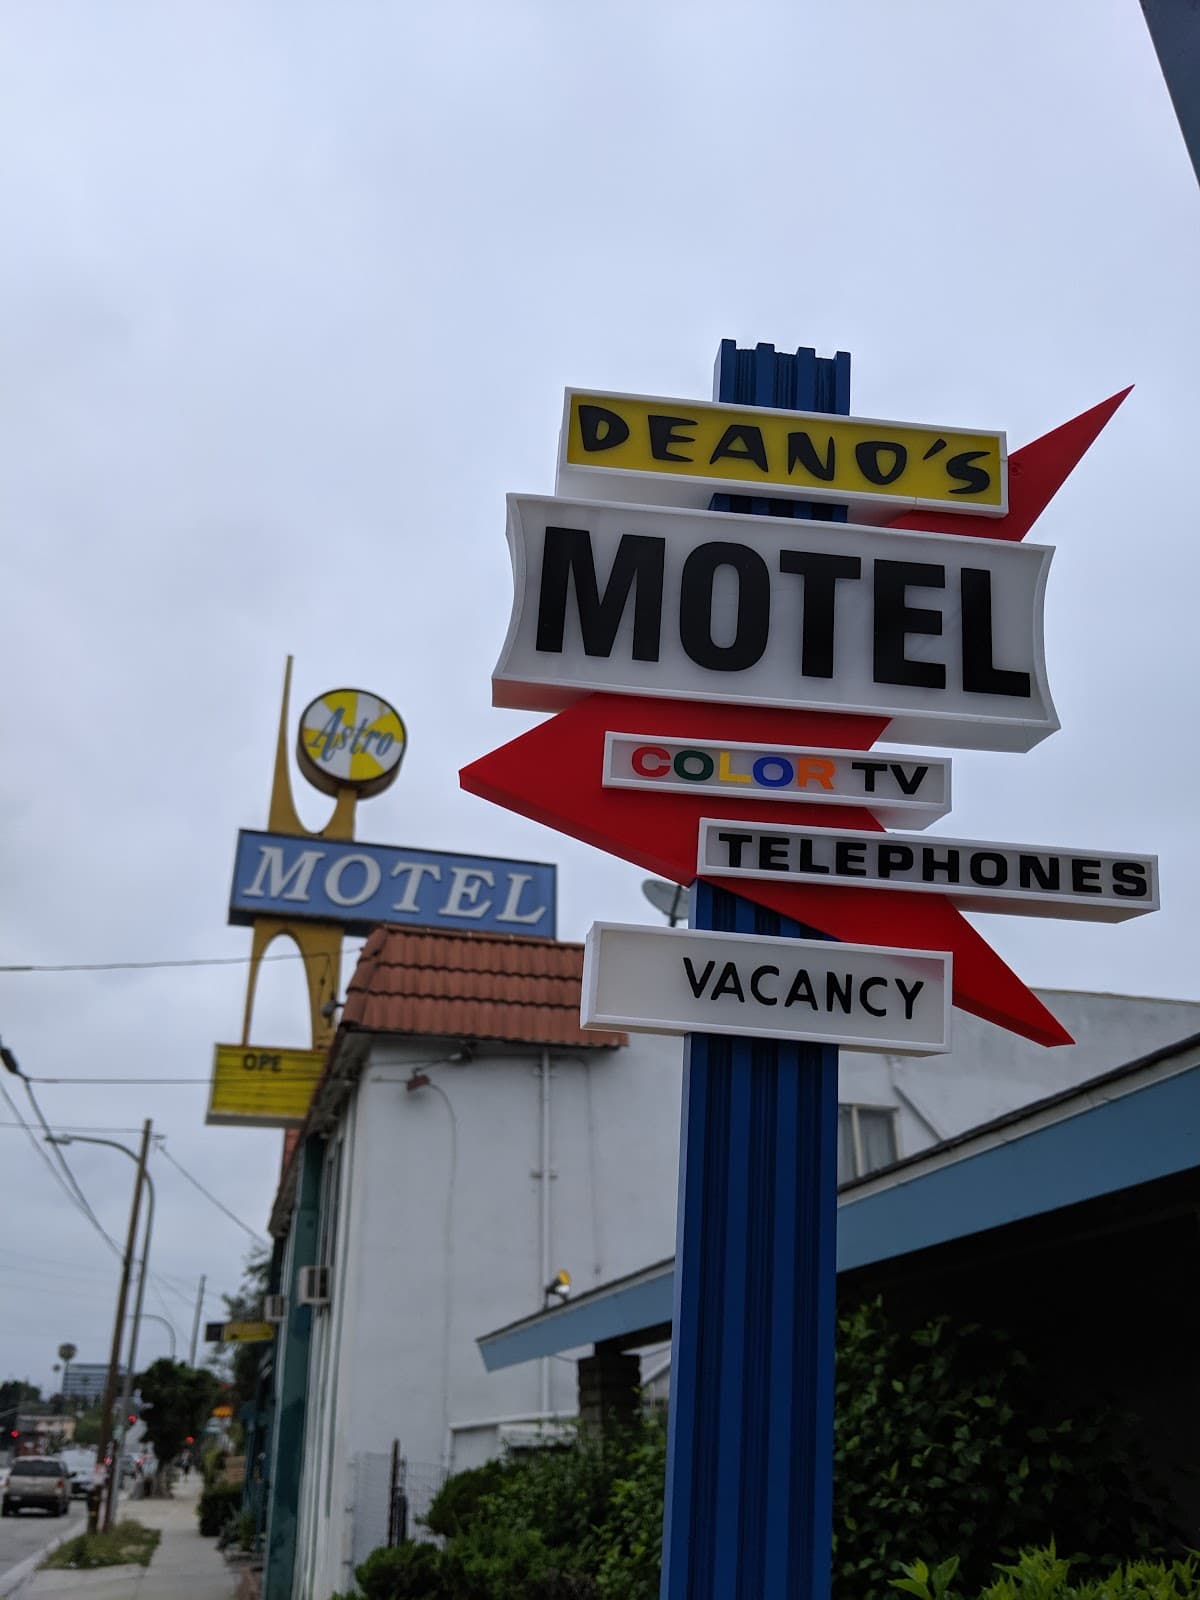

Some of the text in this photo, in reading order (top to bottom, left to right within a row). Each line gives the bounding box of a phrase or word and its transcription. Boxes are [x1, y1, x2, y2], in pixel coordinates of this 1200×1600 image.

[578, 405, 992, 495] DEANO'S
[536, 526, 1031, 698] MOTEL
[308, 707, 395, 762] Astro
[631, 746, 929, 795] COLOR TV
[243, 845, 547, 925] MOTEL
[718, 833, 1148, 897] TELEPHONES
[683, 957, 924, 1020] VACANCY
